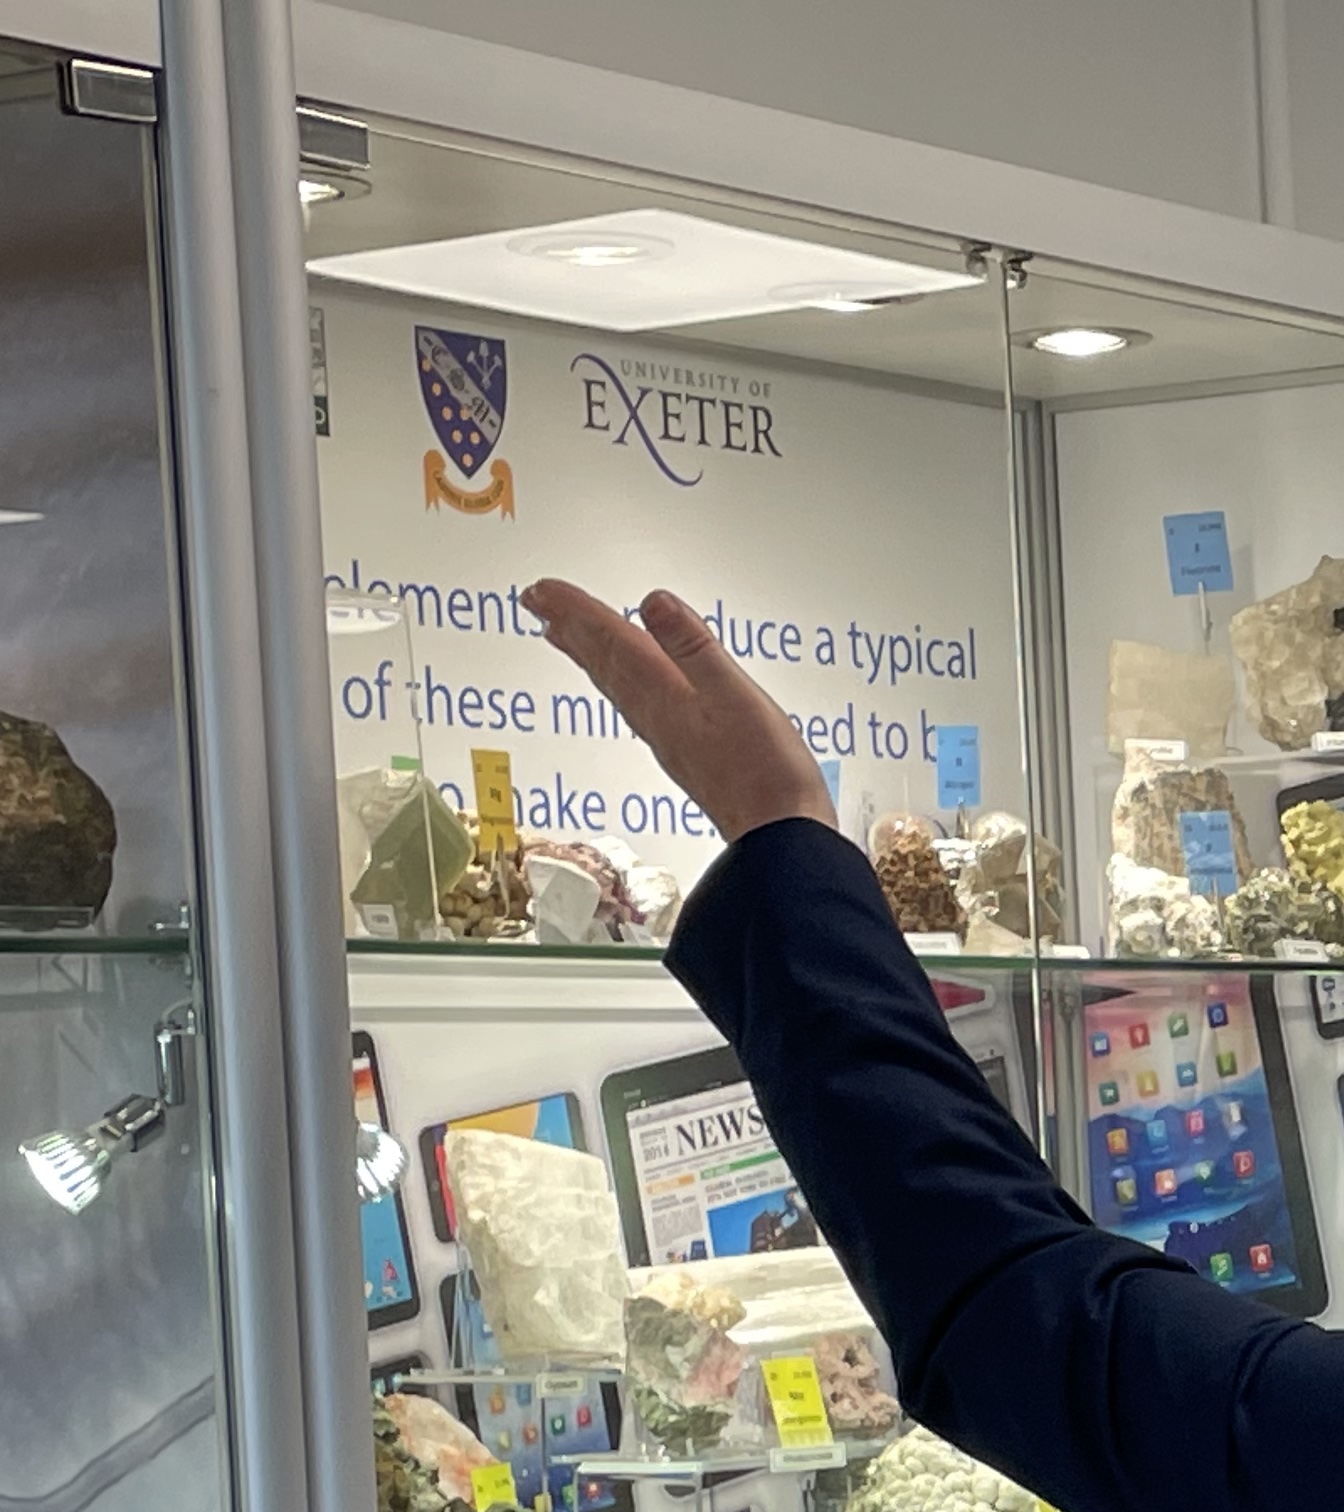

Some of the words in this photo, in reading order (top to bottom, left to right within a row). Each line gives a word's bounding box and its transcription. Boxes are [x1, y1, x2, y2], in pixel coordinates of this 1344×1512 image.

[620, 359, 739, 394] UNIVERSITY
[748, 380, 772, 398] OF
[570, 353, 783, 486] EXETER
[815, 626, 835, 665] a
[848, 620, 977, 686] typical
[342, 660, 393, 721] of
[868, 712, 909, 760] to
[675, 1105, 765, 1157] NEWS
